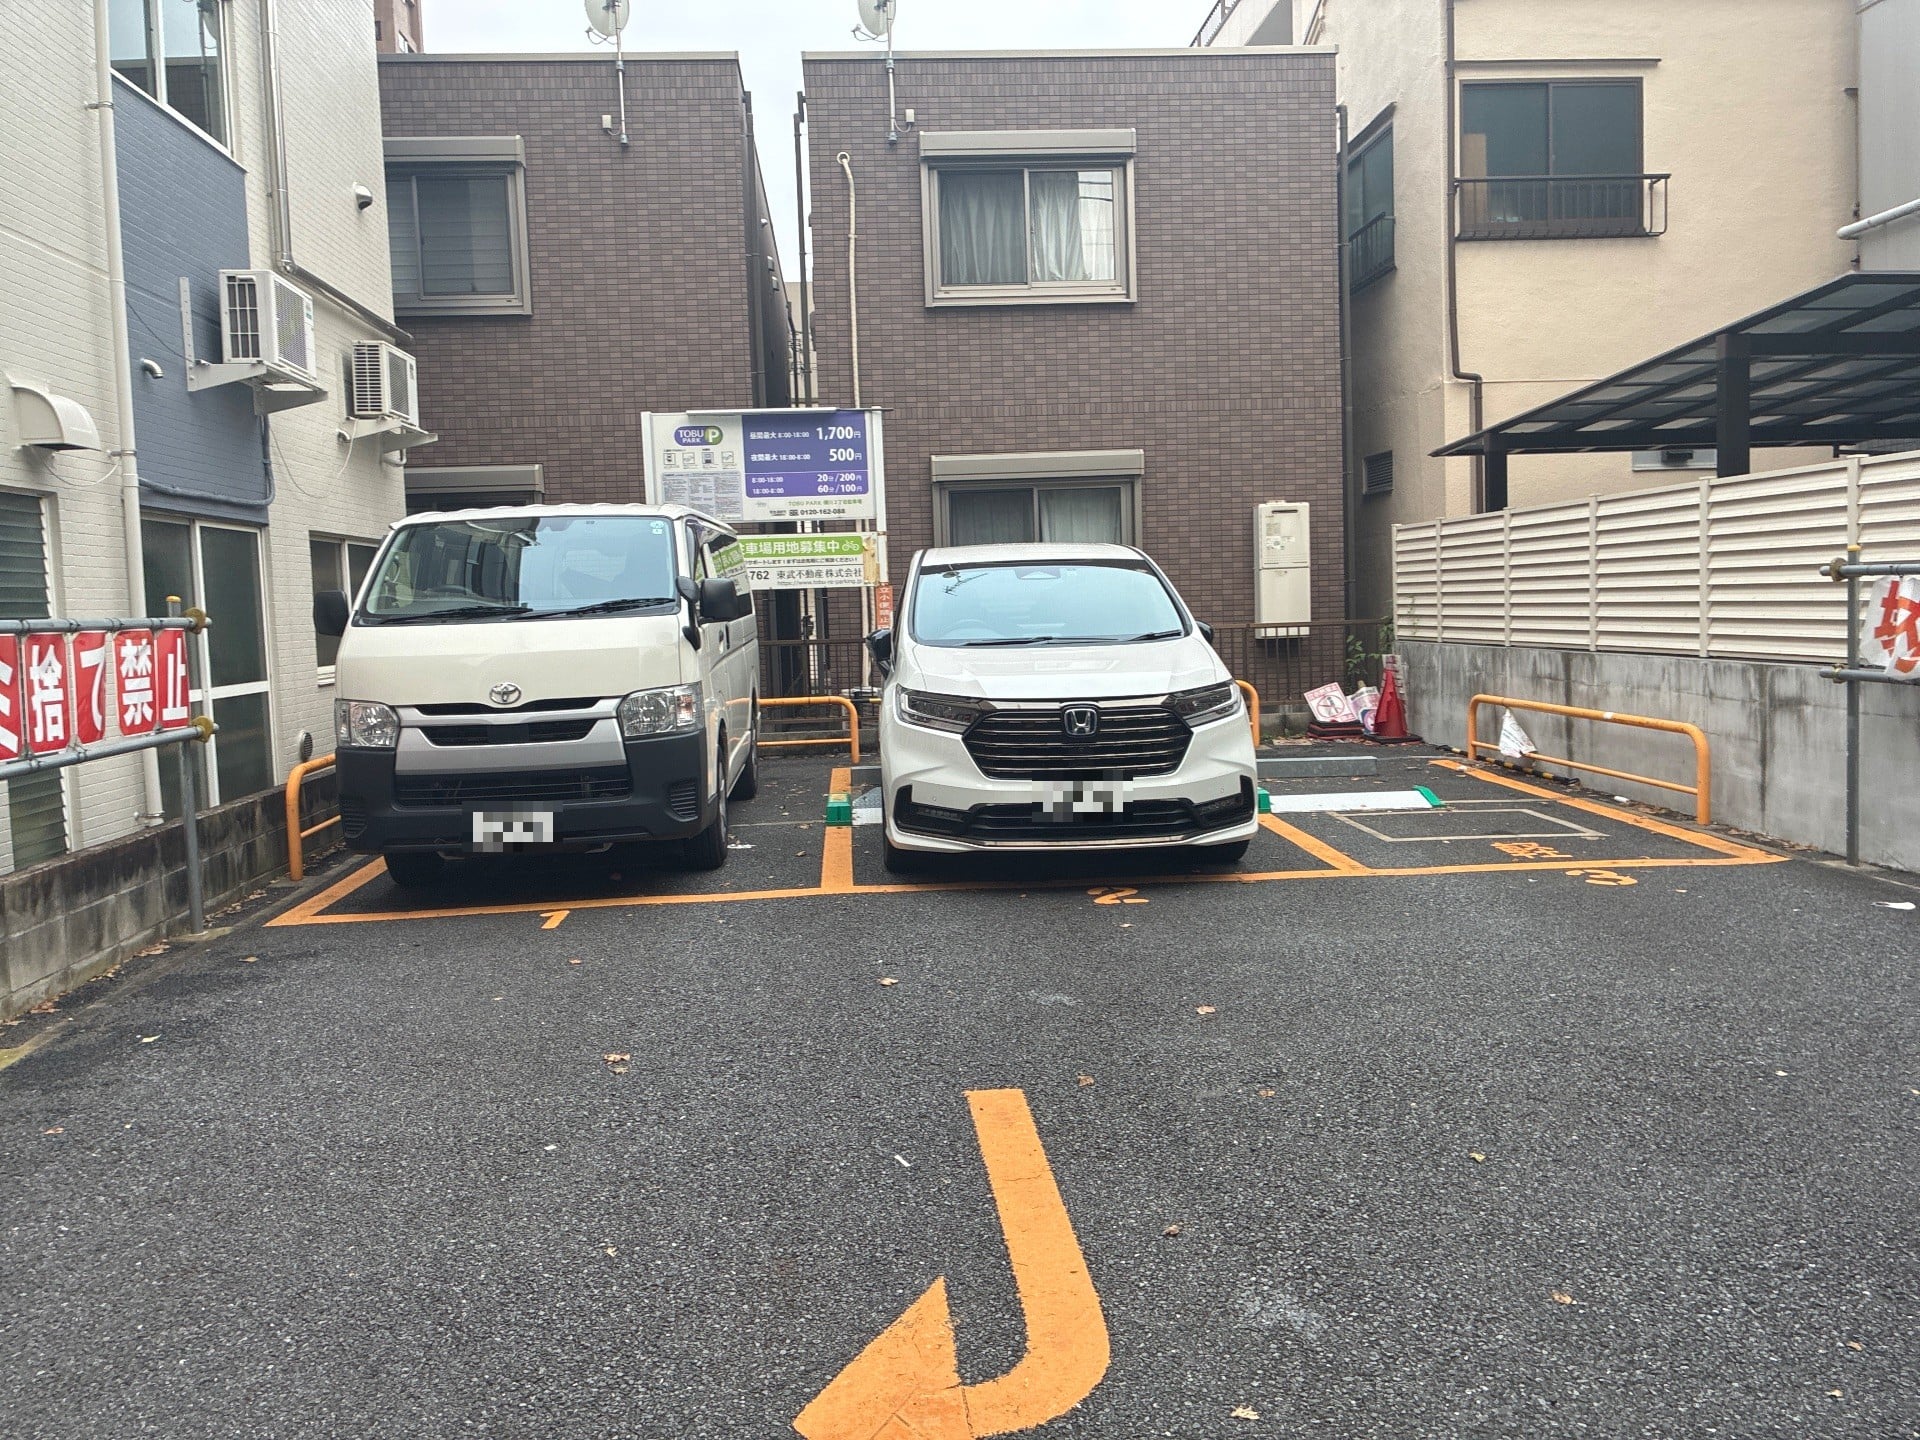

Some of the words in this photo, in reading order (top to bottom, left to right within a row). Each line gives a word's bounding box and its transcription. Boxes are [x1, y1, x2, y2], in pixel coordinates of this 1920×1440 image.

[678, 429, 704, 439] TOBU
[816, 426, 861, 441] 1,700円
[750, 453, 778, 462] 夜間最大
[829, 448, 863, 462] 500円
[1565, 869, 1638, 886] 3
[1087, 886, 1150, 905] 2
[540, 910, 570, 929] 1
